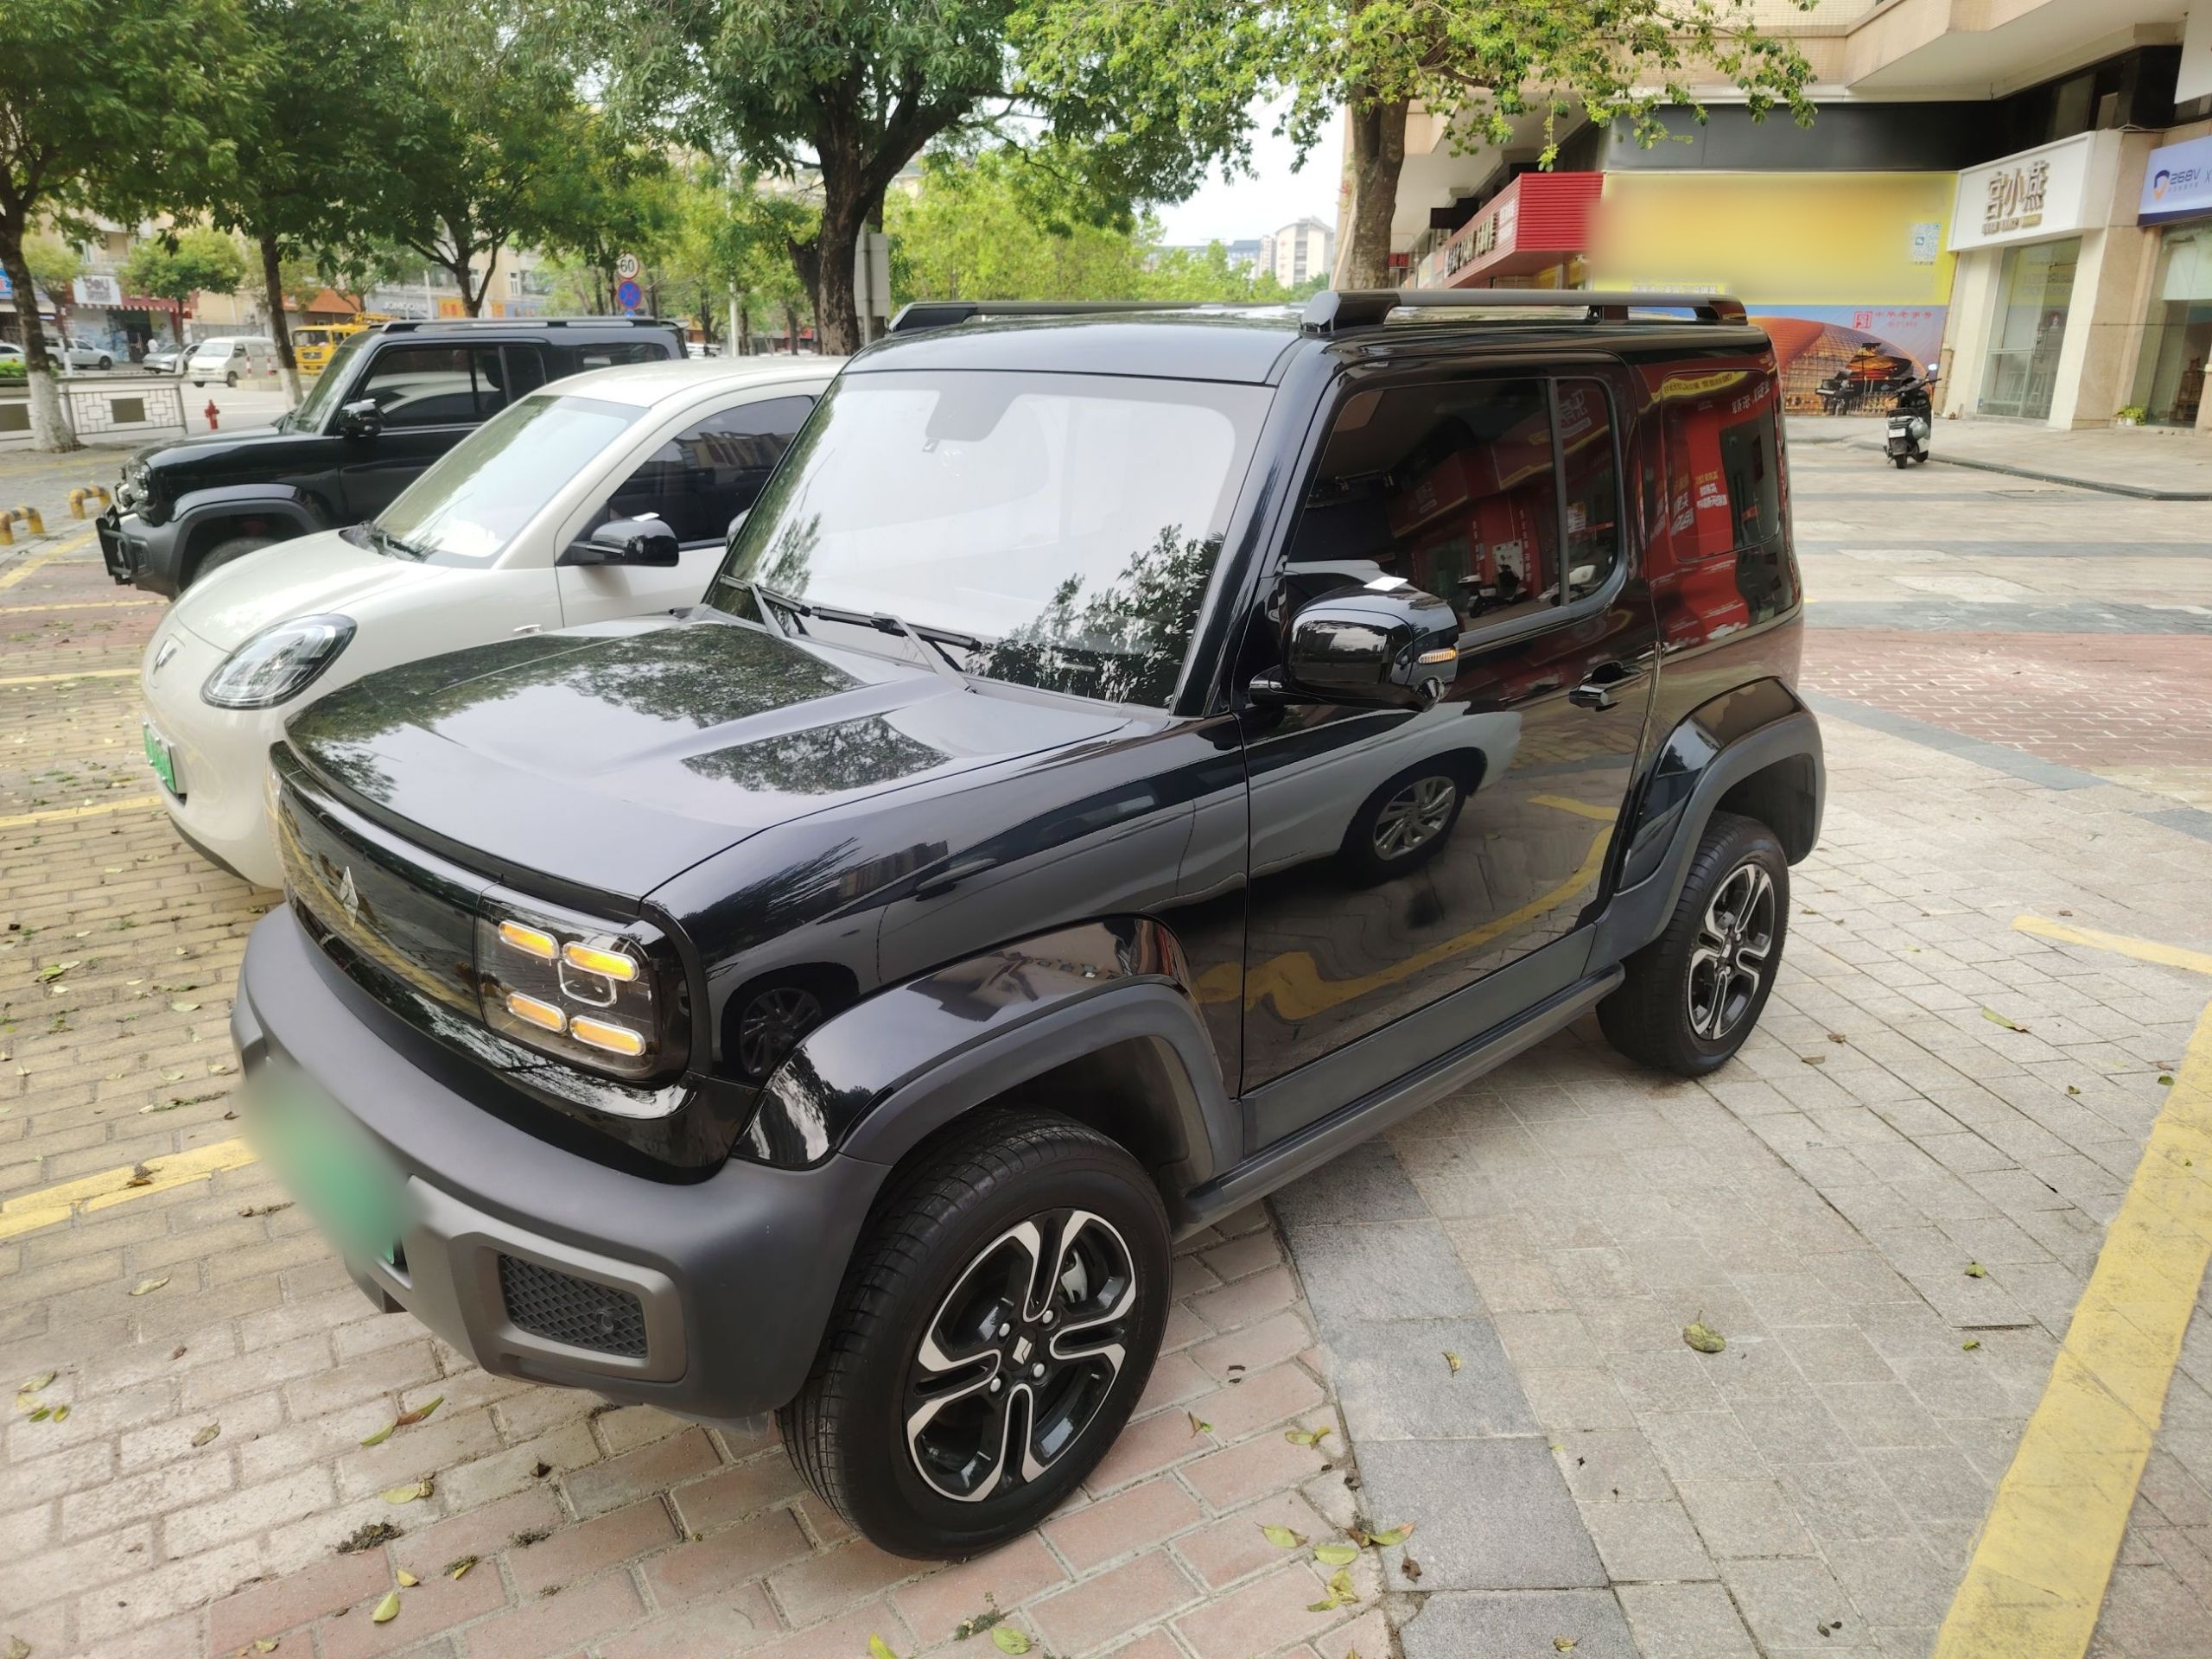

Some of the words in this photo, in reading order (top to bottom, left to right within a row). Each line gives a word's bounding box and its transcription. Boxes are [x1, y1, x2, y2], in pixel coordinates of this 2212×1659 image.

[1985, 160, 2050, 220] 宫小燕
[620, 258, 635, 273] 60
